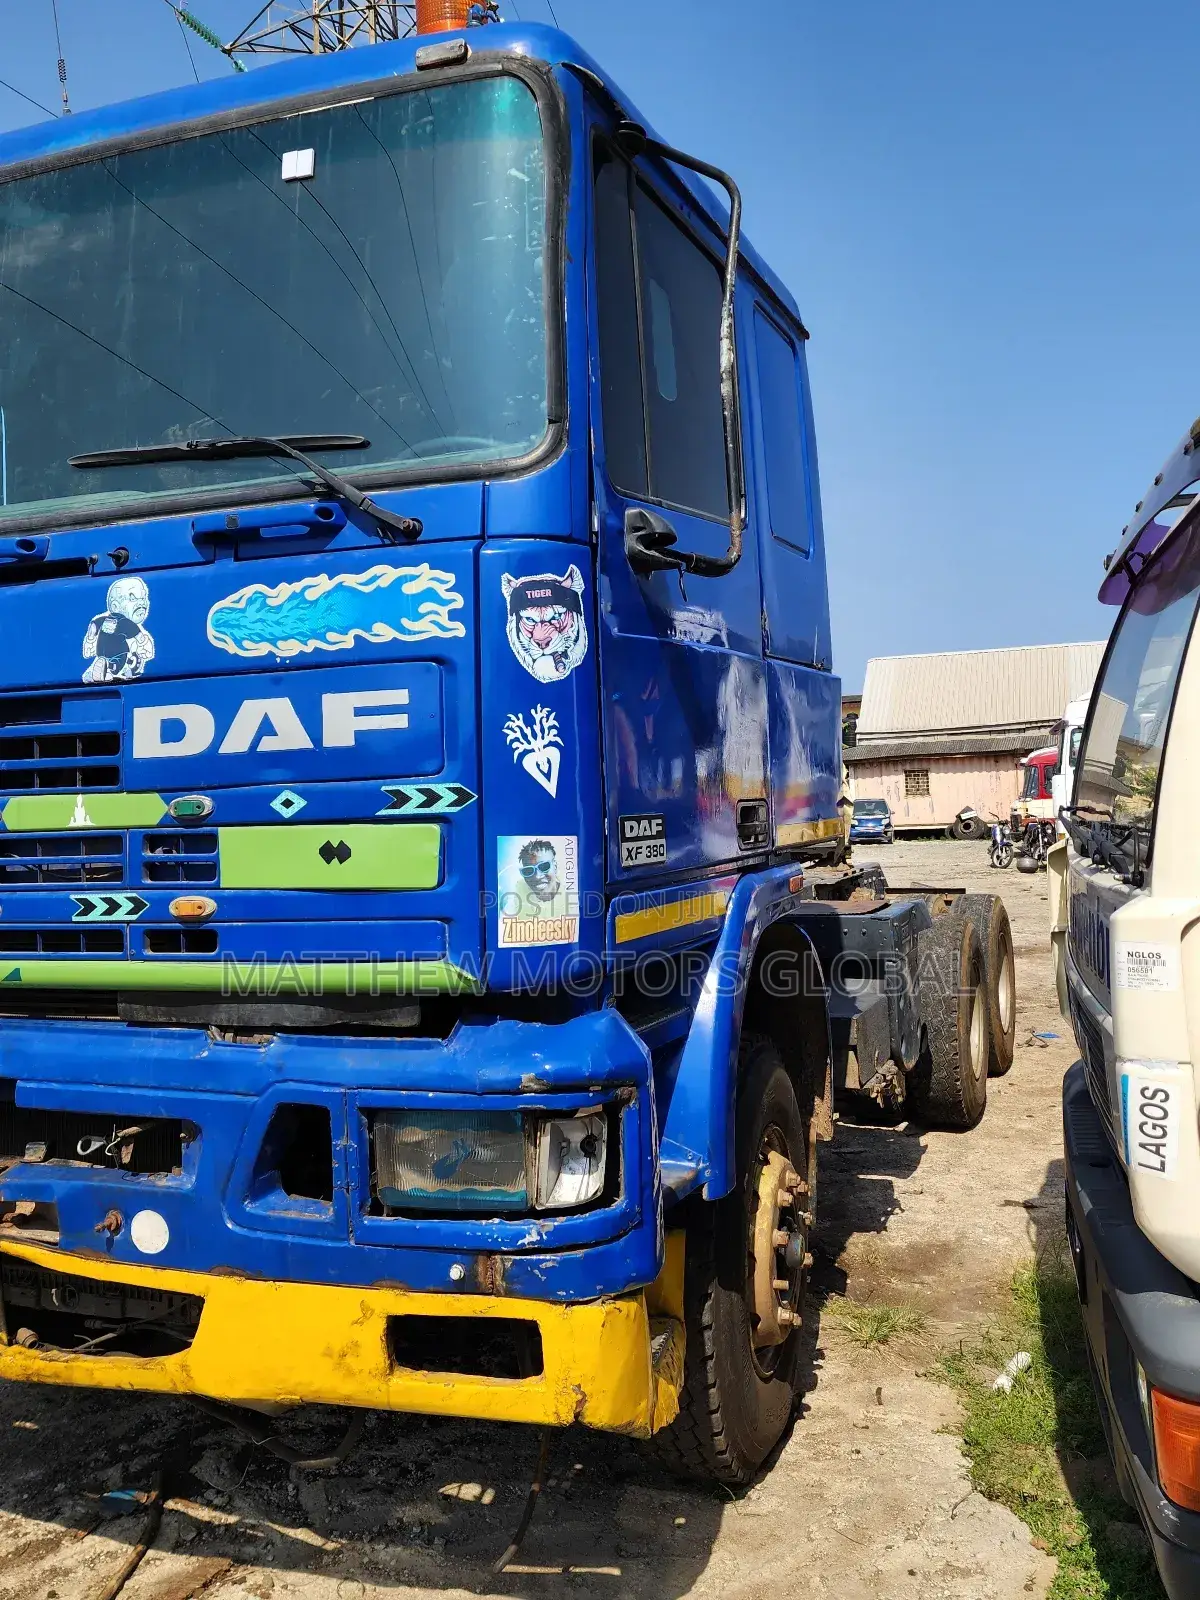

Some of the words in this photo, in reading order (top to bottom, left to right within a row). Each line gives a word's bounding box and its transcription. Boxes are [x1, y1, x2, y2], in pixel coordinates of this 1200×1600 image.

[526, 588, 552, 598] TIGER
[132, 689, 410, 759] DAF
[624, 819, 663, 837] DAF
[625, 846, 643, 861] XF
[645, 843, 665, 858] 380
[564, 837, 575, 891] ADIGUN
[503, 914, 577, 943] Zinoleesky
[1127, 951, 1162, 959] NGLOS
[1137, 1085, 1170, 1173] LAGOS
